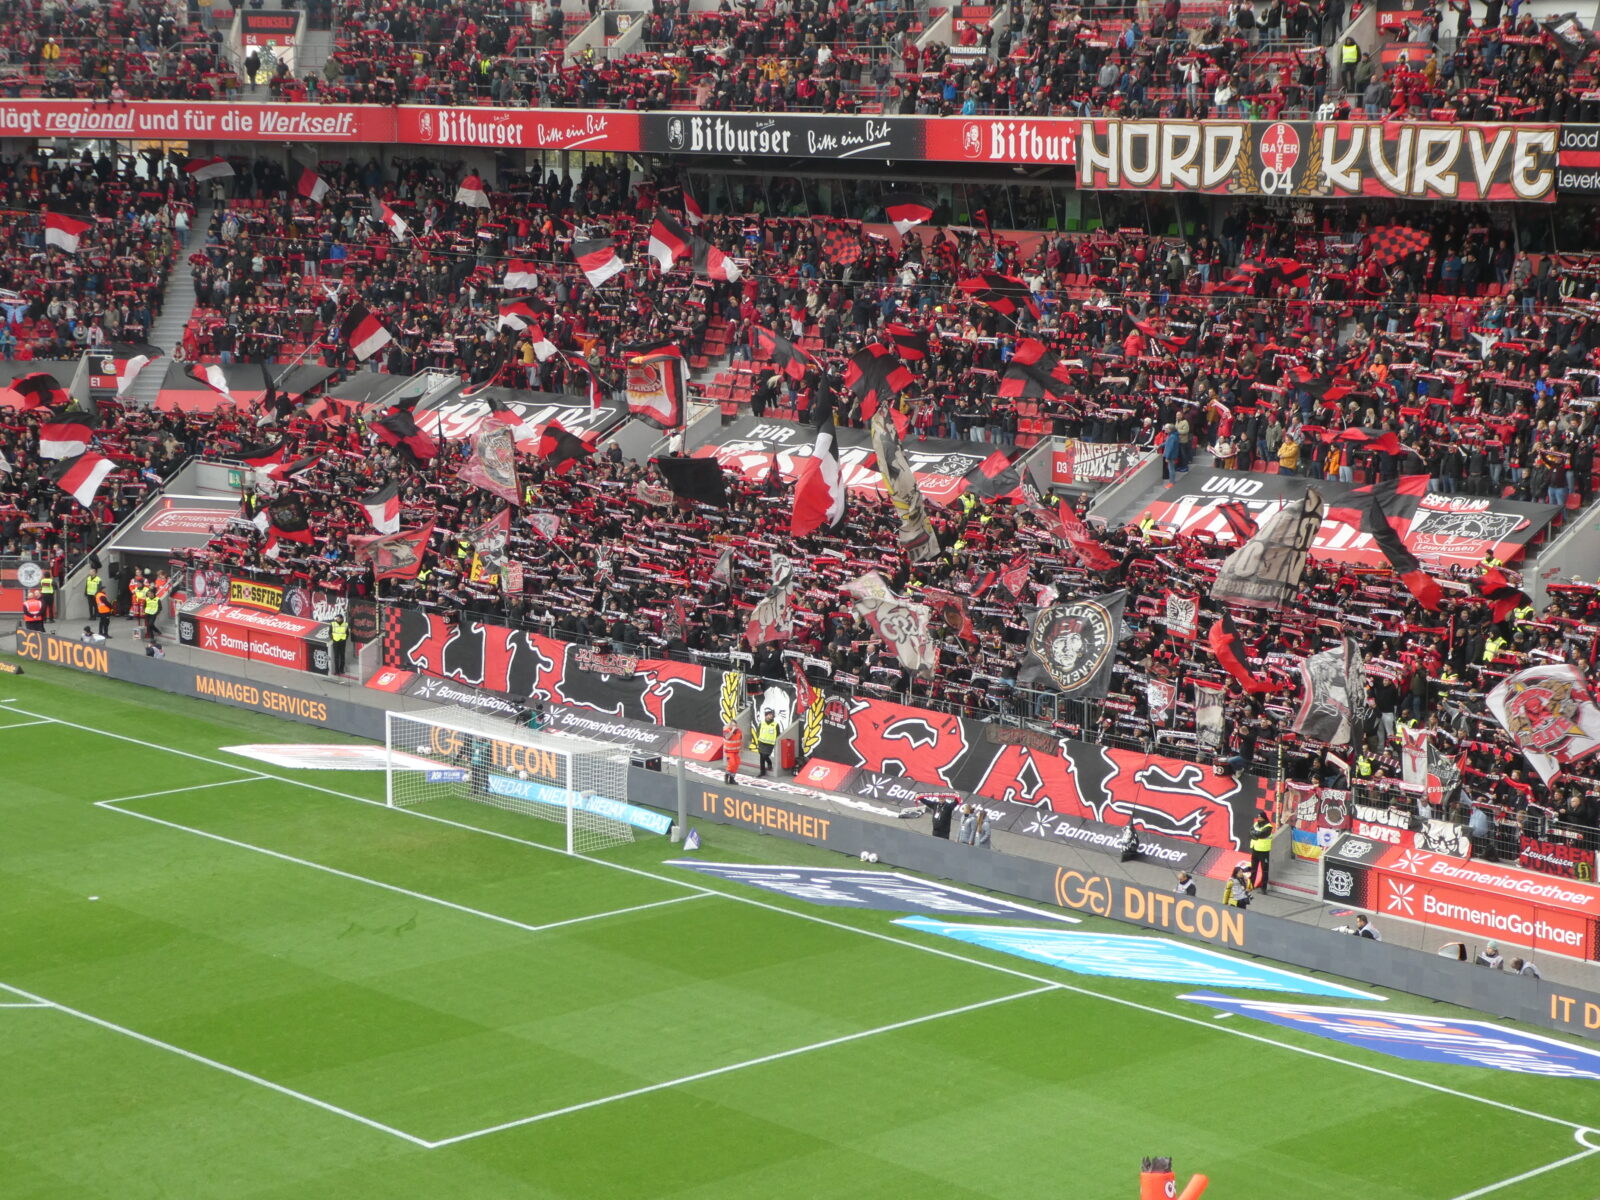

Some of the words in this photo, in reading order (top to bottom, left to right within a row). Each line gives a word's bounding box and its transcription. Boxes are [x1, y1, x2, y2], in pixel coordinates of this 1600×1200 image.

[246, 34, 257, 44] E4
[45, 108, 135, 133] regional
[139, 109, 179, 130] und
[183, 110, 216, 131] für
[220, 111, 253, 131] die
[259, 111, 357, 134] Werkself.
[438, 111, 523, 145] Bitburger
[566, 125, 586, 139] ein
[586, 114, 608, 135] Bit
[690, 116, 791, 154] Bitburger
[840, 131, 864, 146] ein
[865, 120, 891, 142] Bit
[1081, 120, 1245, 188] NORD
[1320, 123, 1558, 199] KURVE
[1260, 166, 1294, 195] 04
[90, 377, 100, 387] E1
[745, 423, 796, 443] FÜR
[1056, 461, 1068, 474] D3
[1200, 475, 1264, 497] UND
[47, 637, 108, 673] DITCON
[220, 633, 297, 662] BarmeniaGothaer
[196, 674, 259, 706] MANAGED
[262, 689, 327, 722] SERVICES
[561, 713, 659, 744] BarmeniaGothaer
[491, 738, 558, 780] ITCON
[629, 806, 670, 834] NIEDAX
[702, 791, 719, 814] IT
[723, 795, 830, 841] SICHERHEIT
[1355, 804, 1409, 830] YOUNG
[1521, 846, 1574, 868] Leverkusen
[1429, 860, 1595, 907] BarmeniaGothaer
[1124, 885, 1245, 947] DITCON
[1423, 894, 1584, 948] BarmeniaGothaer
[1551, 993, 1576, 1024] IT
